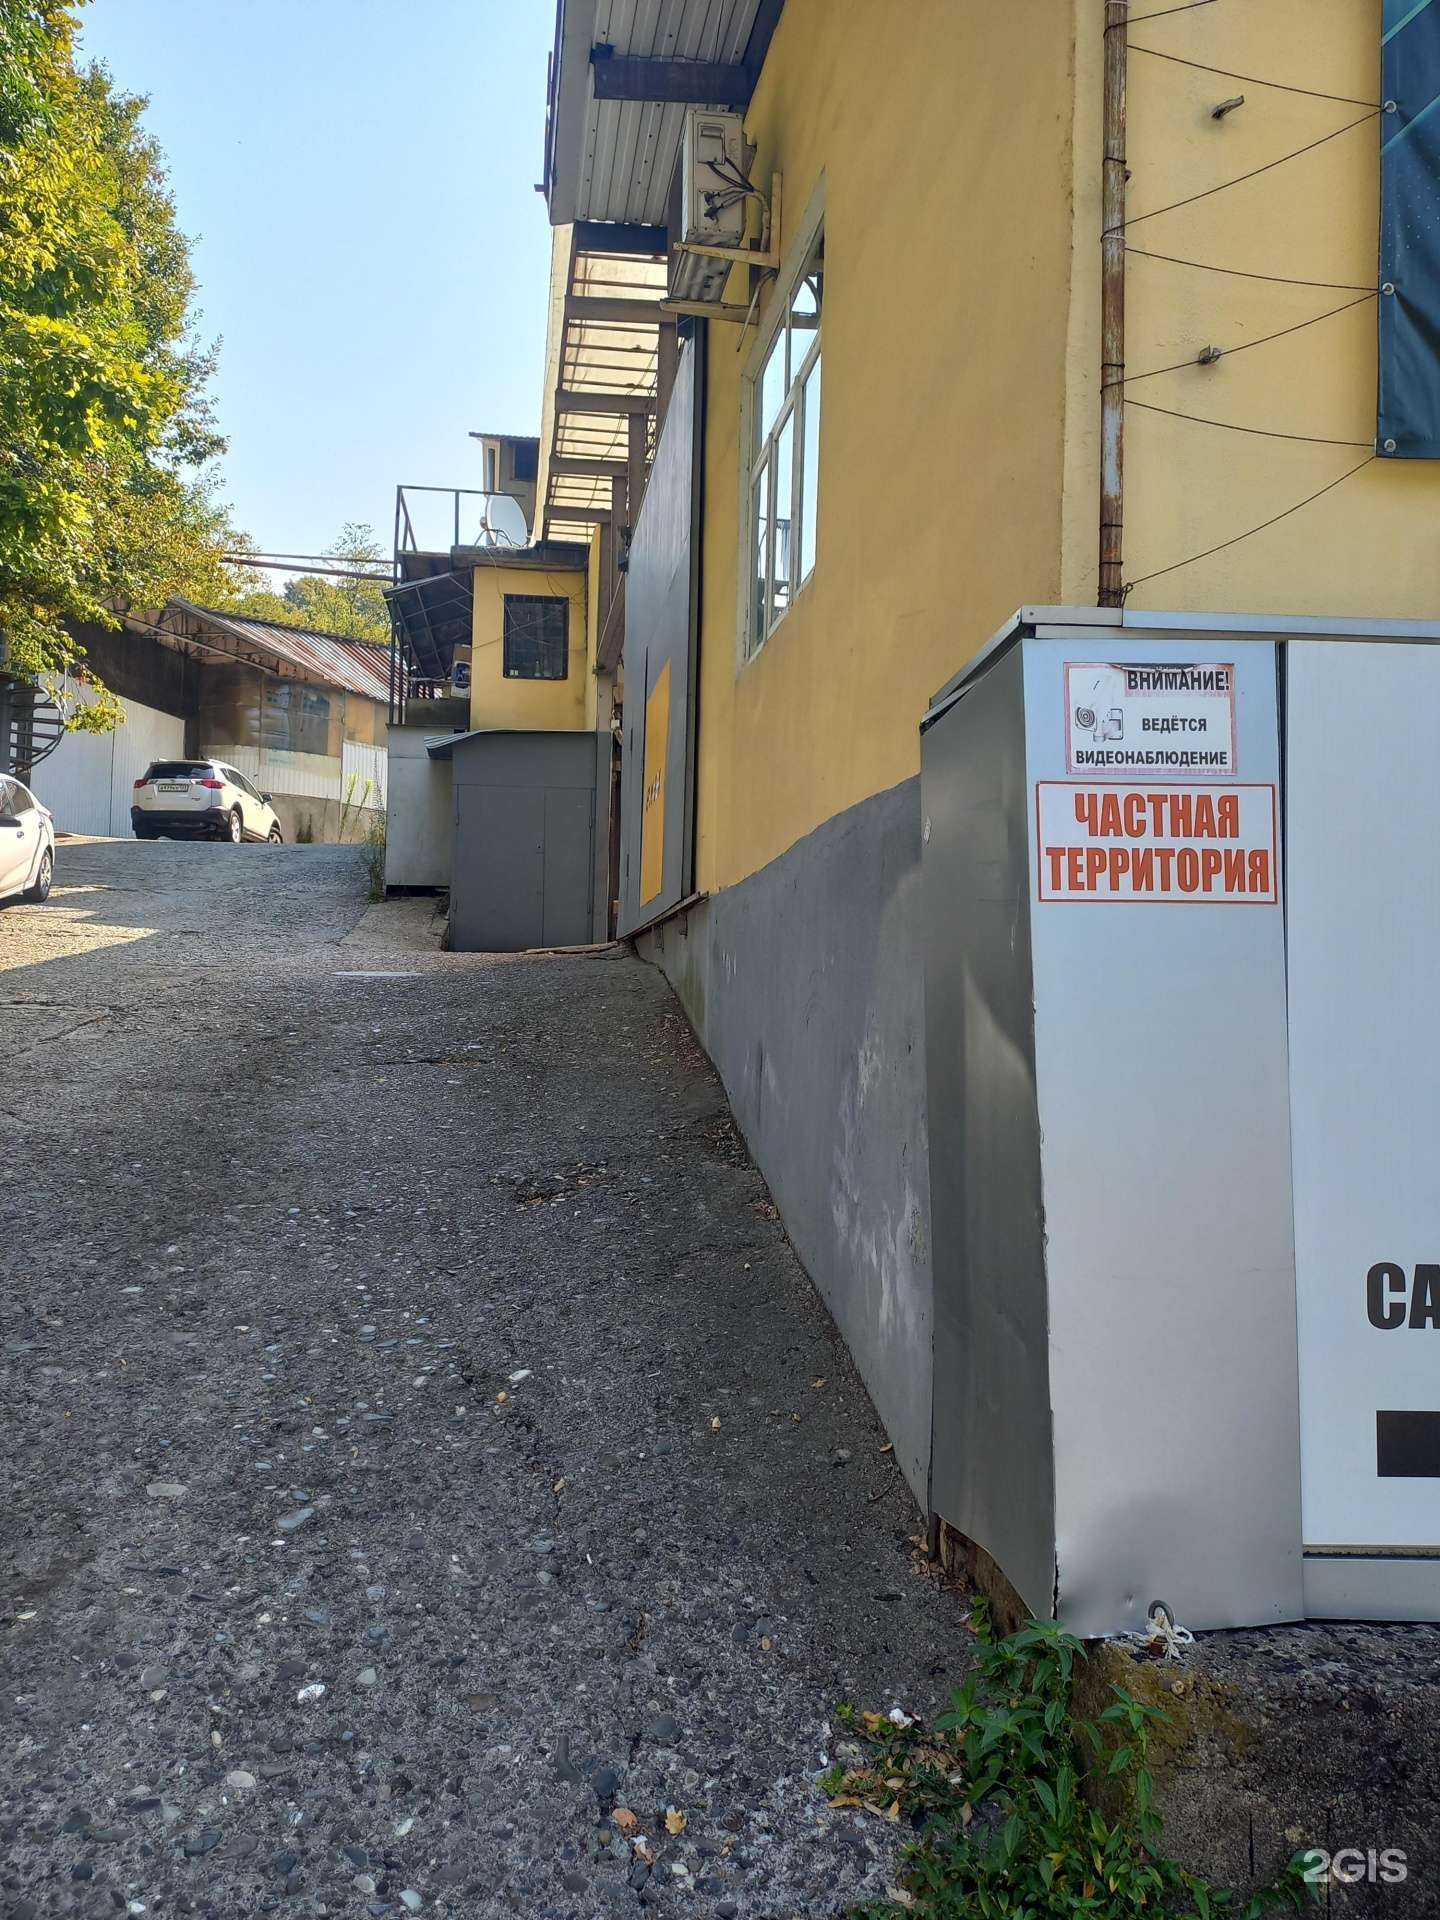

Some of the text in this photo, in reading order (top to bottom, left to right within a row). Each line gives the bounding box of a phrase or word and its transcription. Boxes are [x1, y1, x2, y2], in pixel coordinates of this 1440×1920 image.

[1127, 670, 1230, 691] ВНИМАНИЕ!
[1141, 714, 1207, 734] ВЕДЁТСЯ
[1076, 750, 1228, 767] ВИДЕОНАБЛЮДЕНИЕ
[1074, 792, 1240, 838] ЧАСТНАЯ
[1046, 846, 1270, 893] ТЕРРИТОРИЯ
